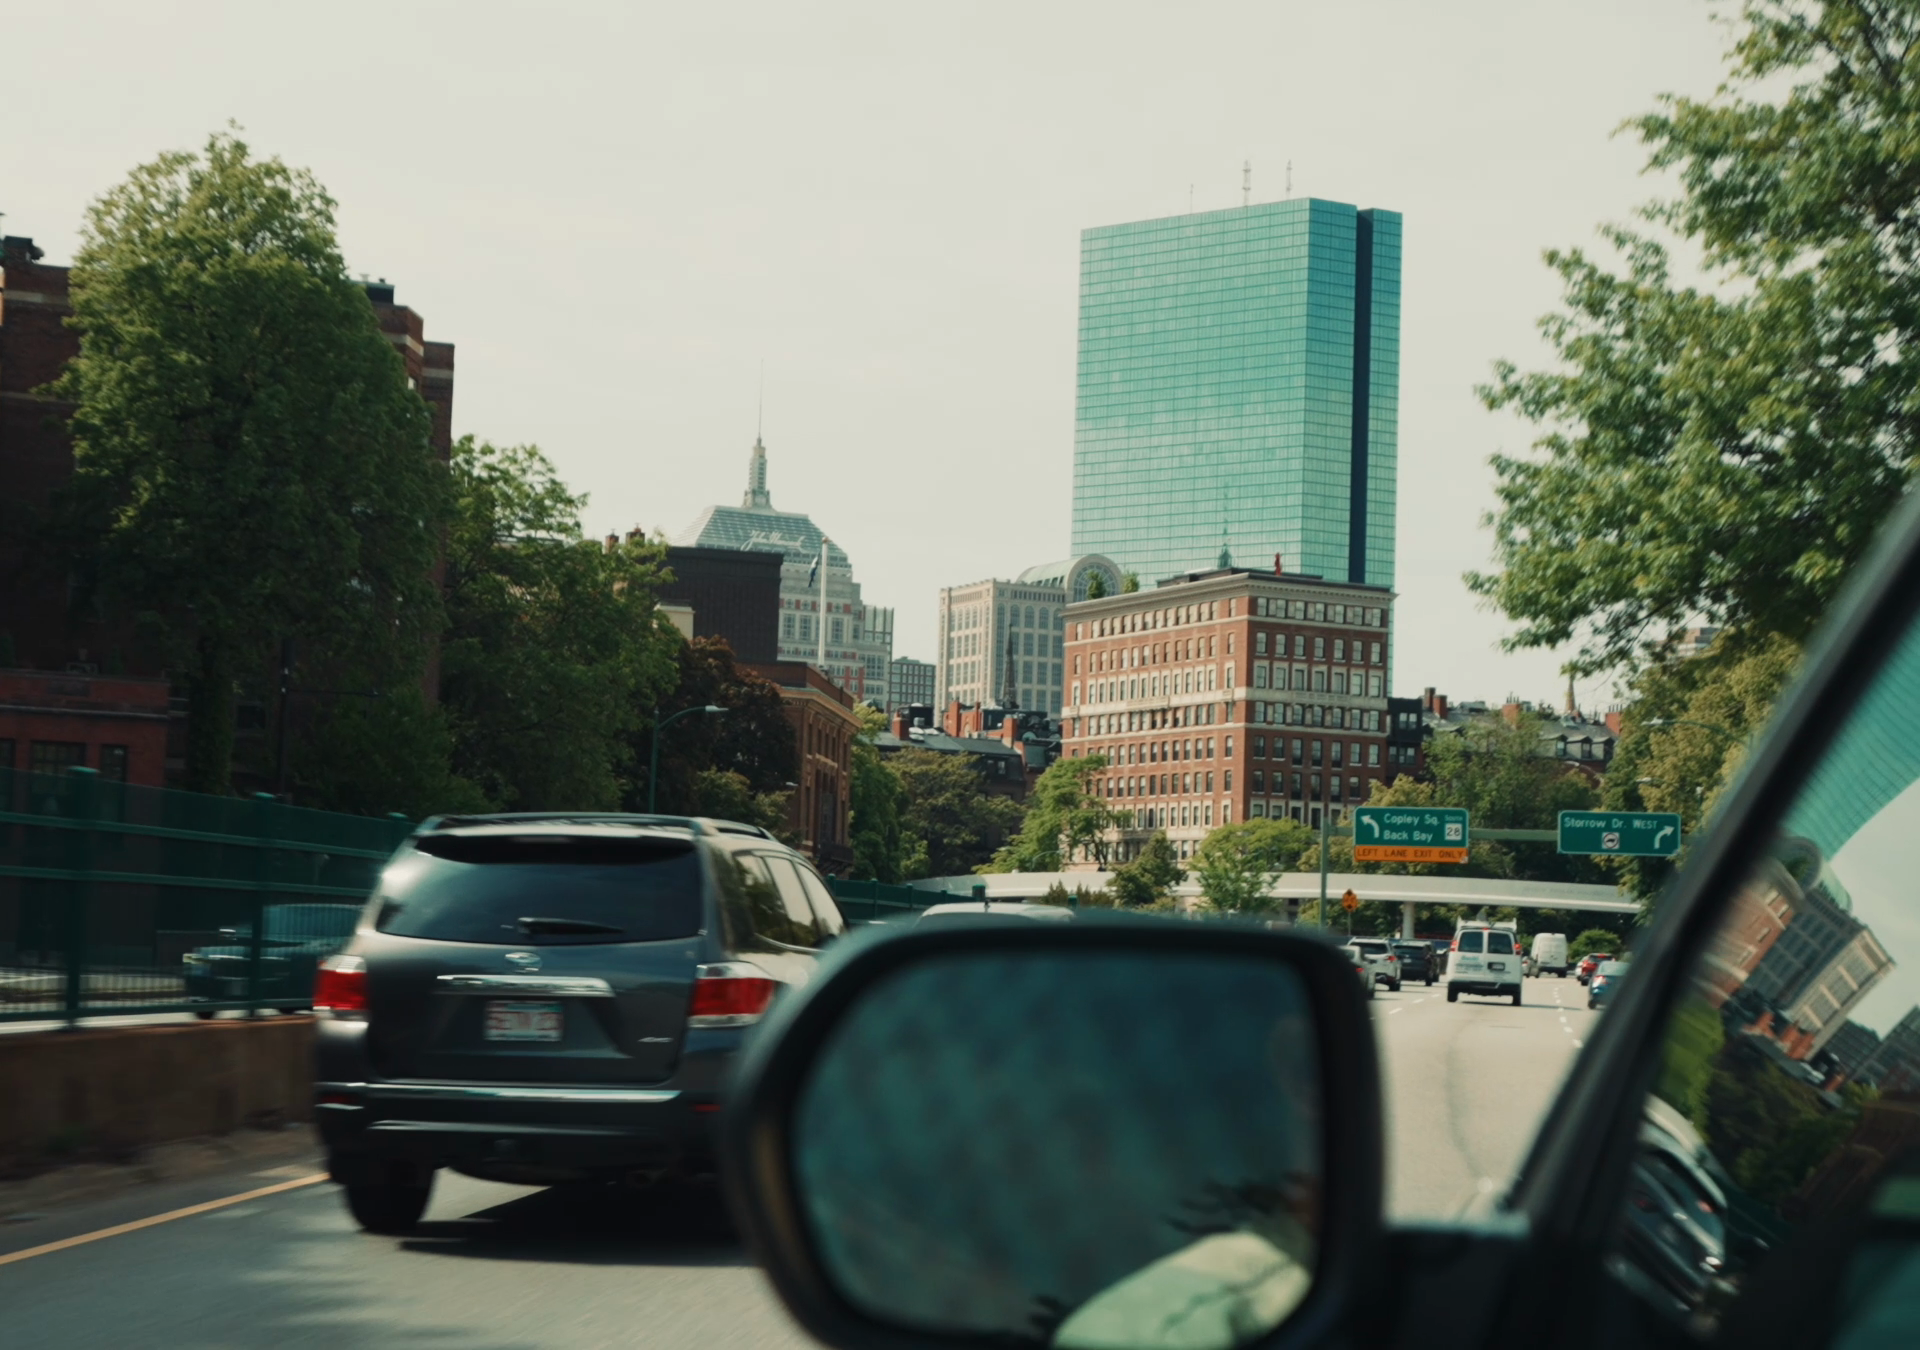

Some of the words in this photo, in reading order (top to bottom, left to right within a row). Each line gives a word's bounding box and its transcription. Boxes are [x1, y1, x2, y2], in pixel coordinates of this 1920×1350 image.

[1384, 813, 1420, 826] Copley
[1424, 814, 1440, 826] Sq.
[1563, 816, 1607, 828] Storrow
[1611, 818, 1627, 828] Dr.
[1632, 819, 1658, 829] WEST
[1383, 830, 1409, 840] Back
[1413, 830, 1433, 843] Bay
[1446, 827, 1461, 837] 28
[1357, 848, 1378, 857] LEFT
[1384, 849, 1408, 858] LANE
[1414, 850, 1432, 858] EXIT
[1438, 850, 1464, 859] ONLY
